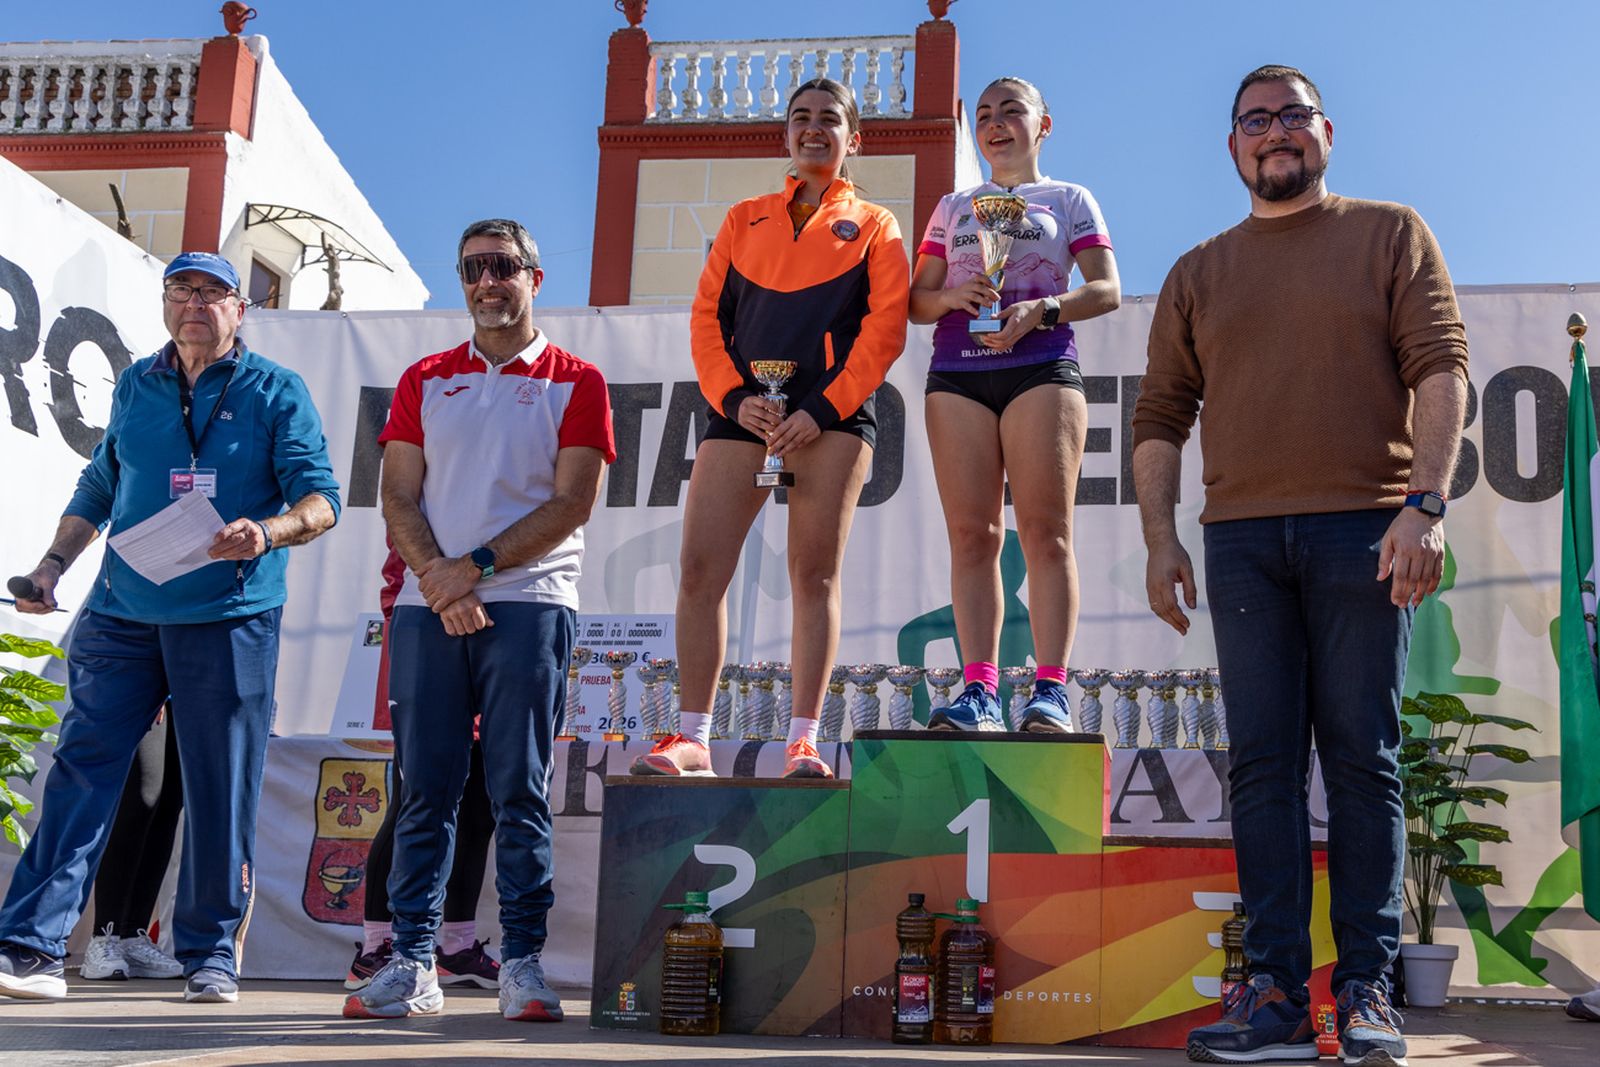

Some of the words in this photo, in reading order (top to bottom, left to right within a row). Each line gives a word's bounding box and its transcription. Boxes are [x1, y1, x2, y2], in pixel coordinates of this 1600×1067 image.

[220, 410, 233, 420] 26
[580, 675, 611, 685] PRUEBA
[946, 798, 990, 903] 1
[694, 844, 756, 948] 2
[1004, 990, 1092, 1004] DEPORTES
